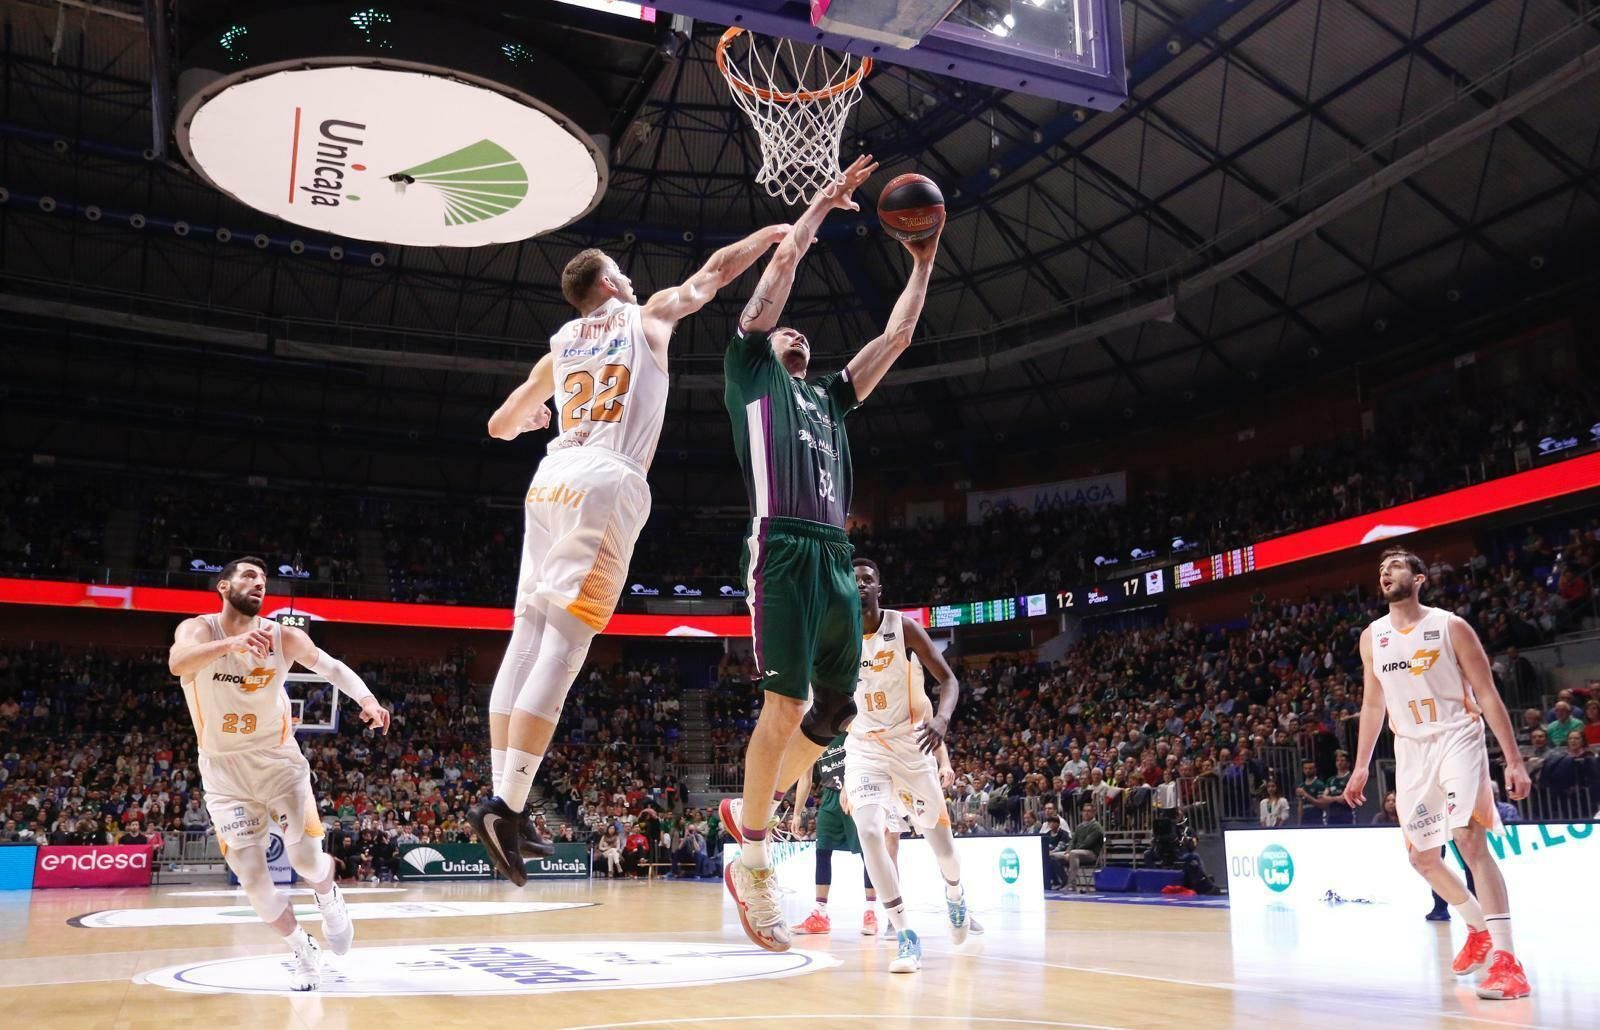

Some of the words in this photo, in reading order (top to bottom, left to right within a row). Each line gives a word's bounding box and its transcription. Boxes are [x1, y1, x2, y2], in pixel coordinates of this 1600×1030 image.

[299, 119, 366, 207] Unicaja
[561, 364, 631, 432] 22
[818, 467, 835, 503] 32
[1123, 578, 1139, 596] 17
[1056, 592, 1074, 609] 12
[282, 616, 305, 627] 26.2
[1382, 656, 1433, 673] KIROLBET
[213, 672, 270, 686] KIROLBET
[864, 691, 887, 712] 19
[1408, 697, 1438, 725] 17
[222, 713, 258, 735] 23
[41, 849, 148, 871] endesa
[442, 859, 491, 874] Unicaja
[540, 858, 587, 874] Unicaja
[1231, 856, 1258, 878] OCI
